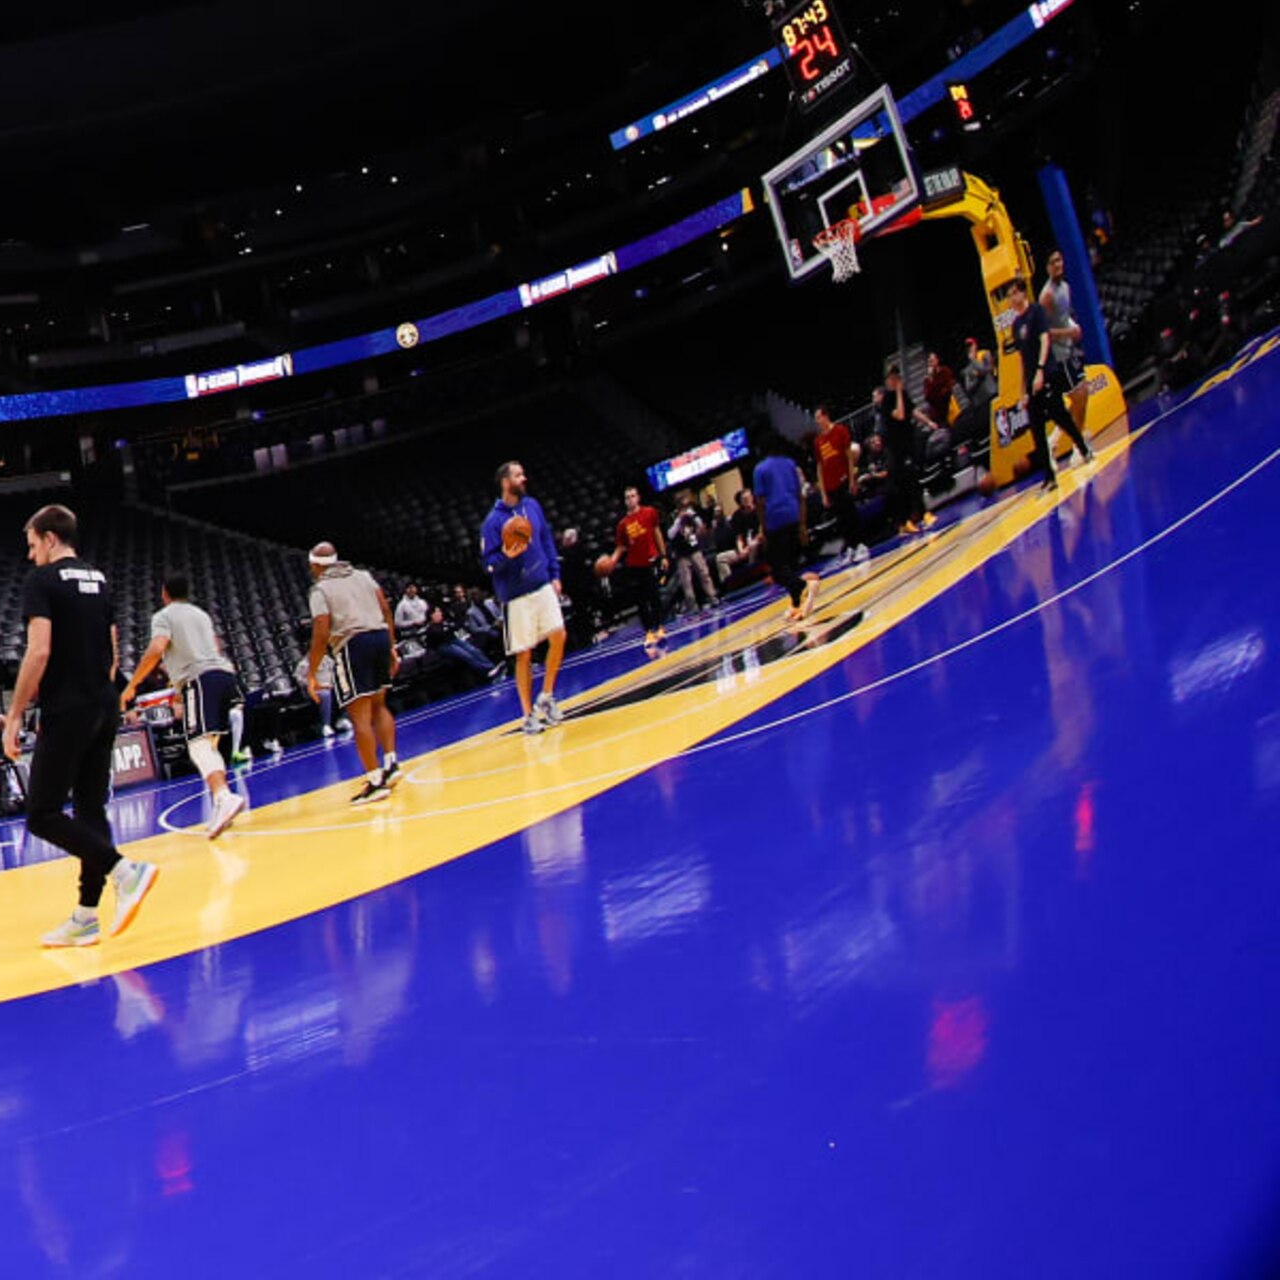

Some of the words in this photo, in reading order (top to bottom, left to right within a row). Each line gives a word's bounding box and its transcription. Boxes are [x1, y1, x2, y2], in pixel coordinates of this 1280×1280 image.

[782, 0, 829, 47] 87:43
[793, 26, 838, 80] 24
[813, 59, 851, 94] TISSOT
